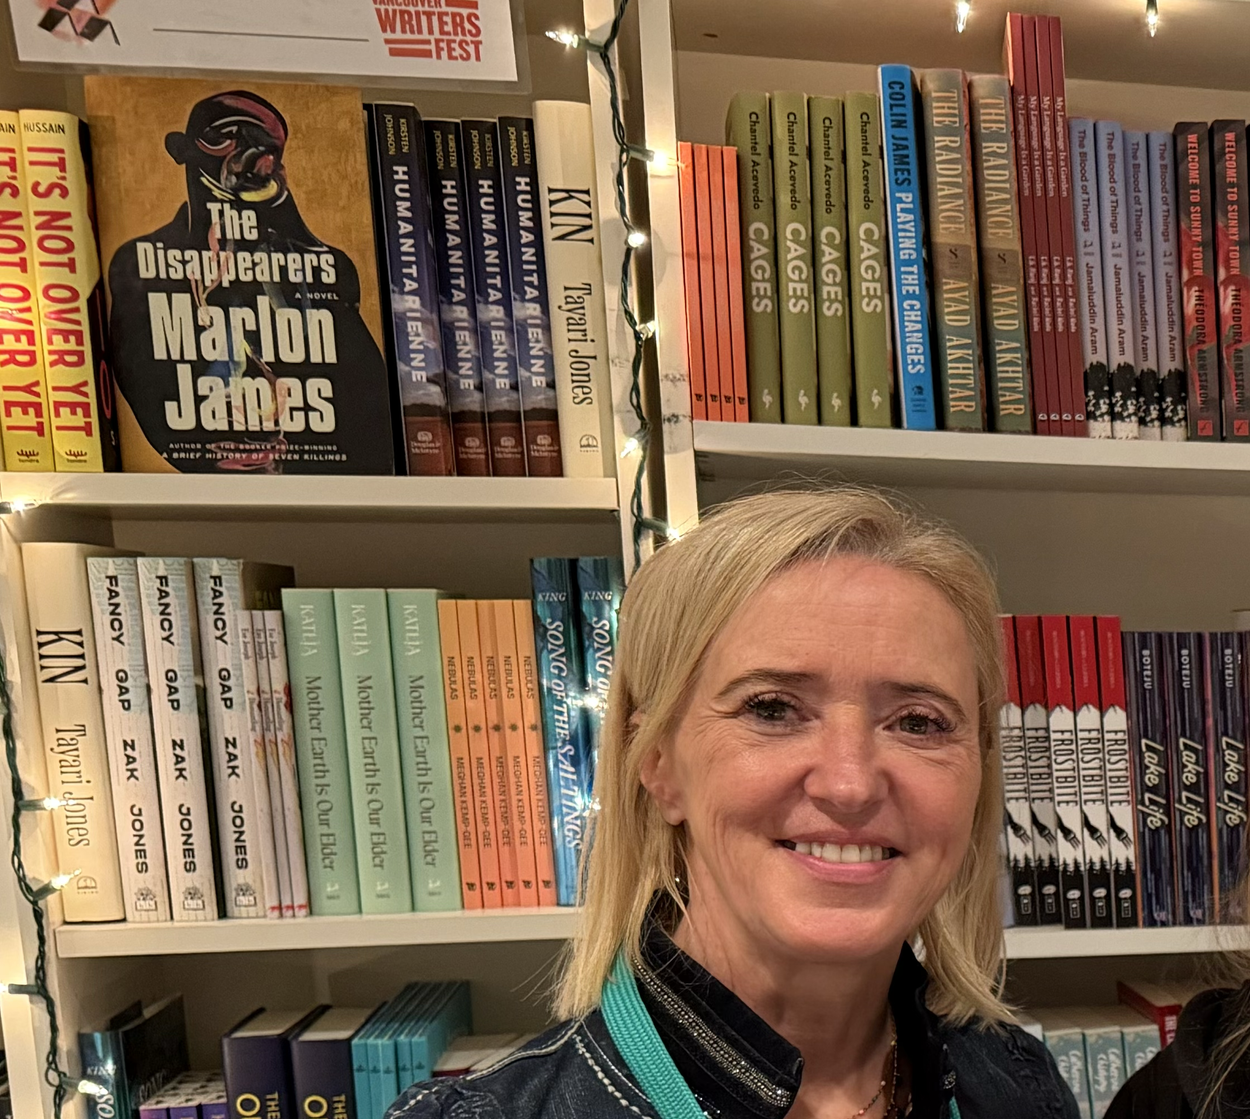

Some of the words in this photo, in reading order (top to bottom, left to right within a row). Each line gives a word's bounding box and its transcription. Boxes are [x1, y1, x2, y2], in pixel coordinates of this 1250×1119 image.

[375, 8, 481, 37] WRITERS
[434, 38, 482, 62] FEST
[23, 121, 66, 135] HUSSAIN
[887, 80, 908, 129] COLIN
[931, 89, 960, 127] THE
[860, 112, 872, 156] Chantel
[1078, 130, 1086, 149] The
[1225, 132, 1237, 183] WELCOME
[26, 145, 71, 201] IT'S
[891, 134, 911, 187] JAMES
[1079, 152, 1088, 182] Blood
[862, 160, 873, 210] Acevedo
[934, 136, 966, 234] RADIANCE
[1081, 184, 1089, 197] of
[1227, 187, 1238, 201] TO
[207, 202, 259, 240] The
[547, 186, 594, 245] KIN
[895, 192, 917, 260] PLAYING
[1081, 197, 1090, 232] Things
[1228, 205, 1239, 241] SUNNY
[33, 210, 76, 275] NOT
[136, 241, 337, 288] Disappearers
[1229, 245, 1240, 275] TOWN
[392, 165, 427, 383] HUMANITARIENNE
[859, 222, 882, 314] CAGES
[900, 265, 919, 295] THE
[558, 282, 595, 344] Tayari
[943, 278, 970, 327] AYAD
[1086, 263, 1096, 325] Jamaluddin
[41, 282, 86, 369] OVER
[147, 292, 338, 364] Marlon
[903, 300, 925, 374] CHANGES
[1090, 327, 1098, 355] Aram
[164, 363, 336, 433] James
[568, 349, 597, 406] Jones
[945, 335, 976, 413] AKHTAR
[1233, 349, 1245, 413] ARMSTRONG
[50, 379, 94, 438] YET
[268, 453, 300, 461] SEVEN
[303, 453, 347, 461] KILLINGS
[105, 575, 125, 646] FANCY
[538, 592, 566, 601] KING
[546, 619, 567, 676] SONG
[1142, 650, 1152, 689] BOTEJU
[115, 669, 131, 711] GAP
[447, 656, 458, 700] NEBULAS
[552, 679, 566, 701] OF
[305, 676, 325, 733] Mother
[553, 703, 570, 741] THE
[123, 739, 139, 782] ZAK
[311, 737, 330, 779] Earth
[1052, 730, 1078, 808] FROSTBITE
[1141, 738, 1165, 787] Lake
[315, 783, 330, 796] Is
[558, 745, 582, 850] SALTINGS
[1137, 792, 1168, 829] Life
[317, 800, 333, 829] Our
[130, 804, 149, 874] JONES
[320, 833, 337, 871] Elder
